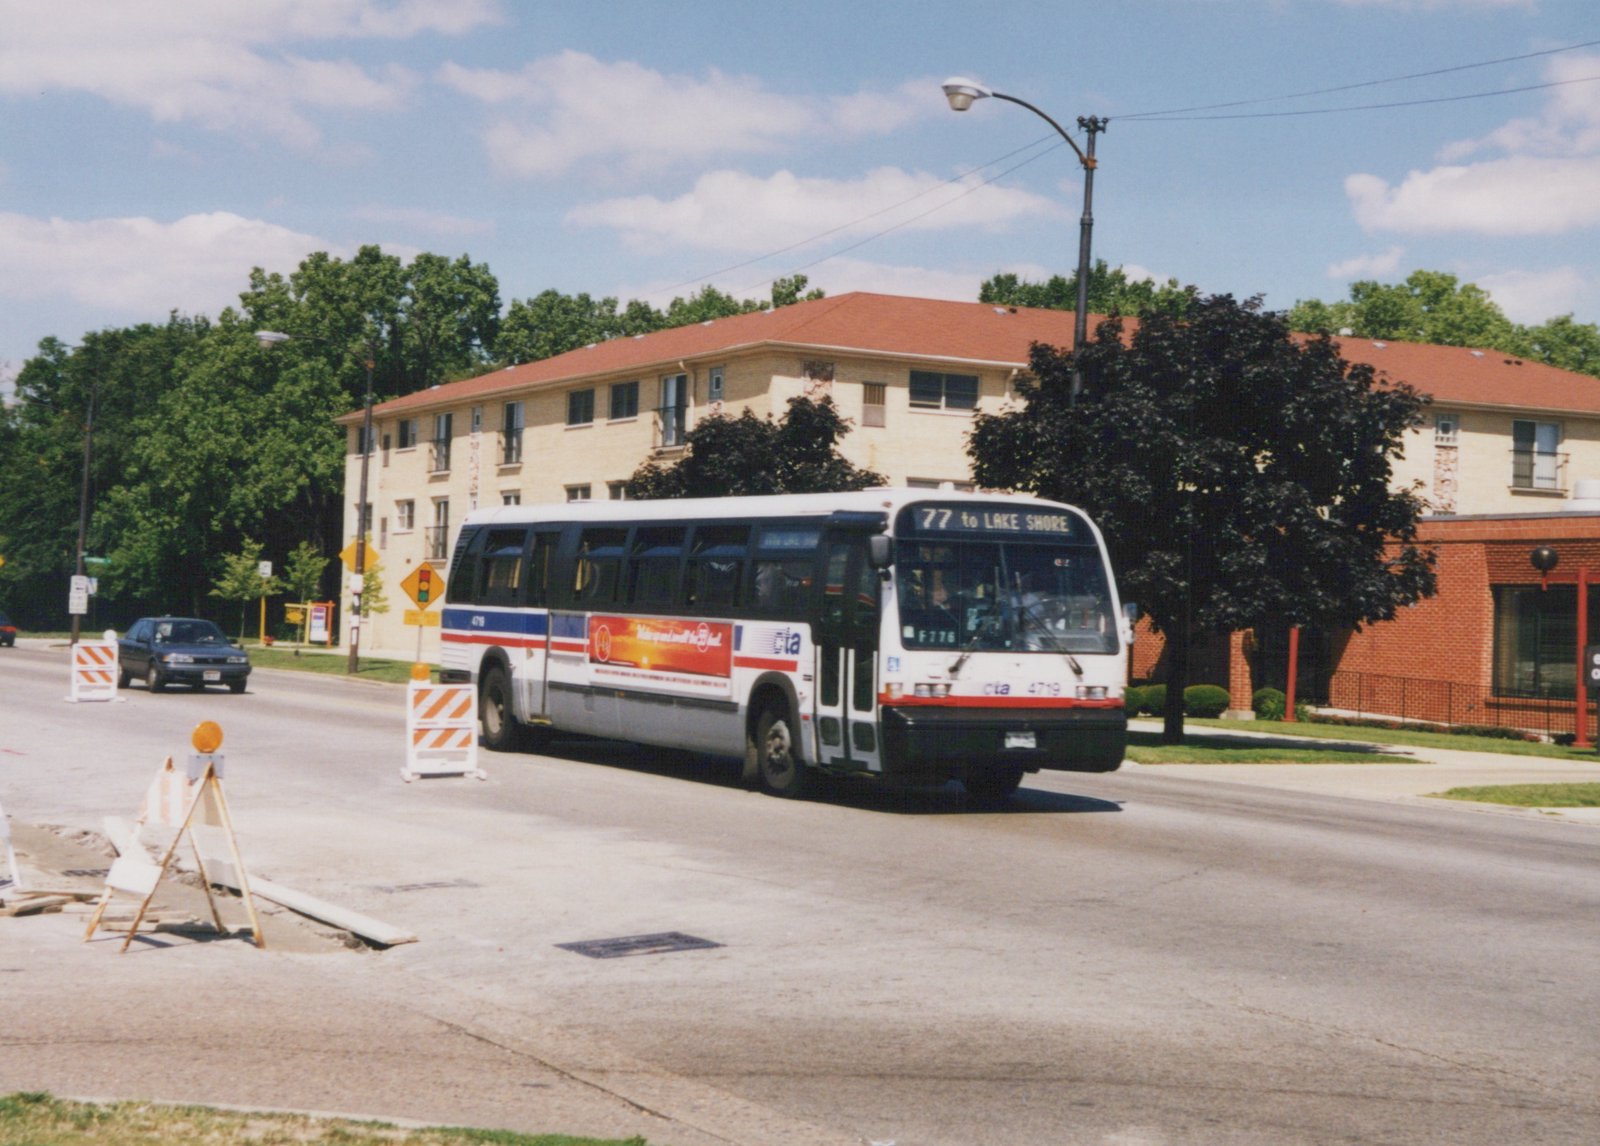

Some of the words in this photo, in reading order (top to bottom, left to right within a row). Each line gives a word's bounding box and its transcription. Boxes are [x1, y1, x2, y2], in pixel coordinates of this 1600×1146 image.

[922, 508, 952, 529] 77
[961, 511, 979, 528] to
[984, 513, 1020, 530] LAKE
[1026, 514, 1069, 532] SHORE
